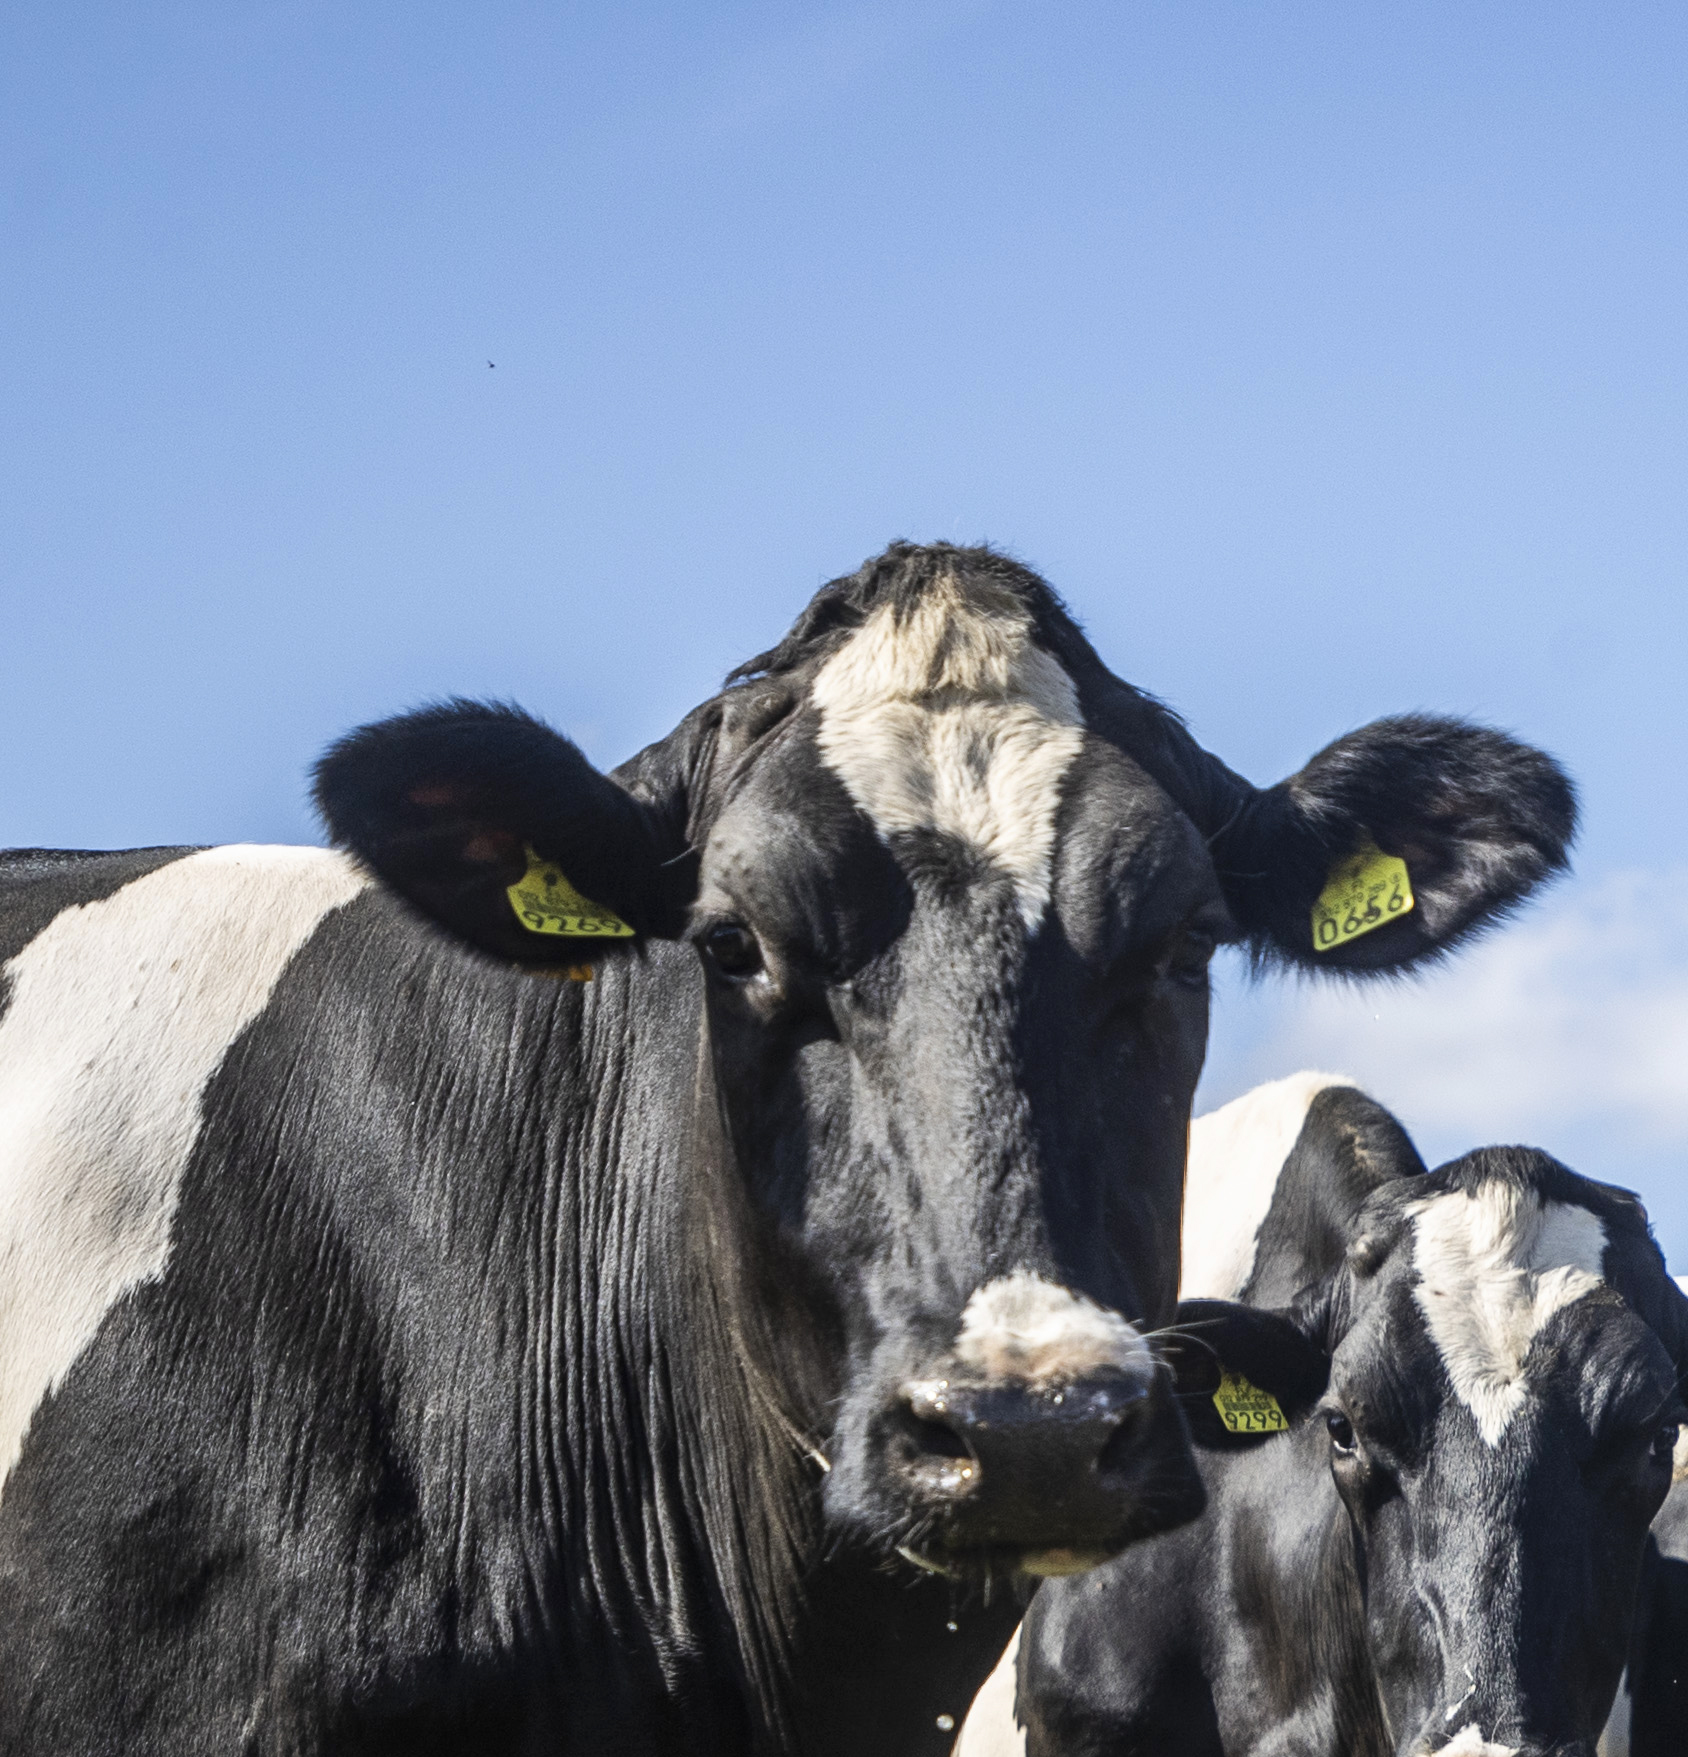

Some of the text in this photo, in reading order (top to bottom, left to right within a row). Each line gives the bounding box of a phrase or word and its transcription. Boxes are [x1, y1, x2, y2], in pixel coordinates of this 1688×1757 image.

[523, 910, 622, 933] 9269
[1319, 884, 1403, 944] 0656
[1225, 1409, 1282, 1429] 9299
